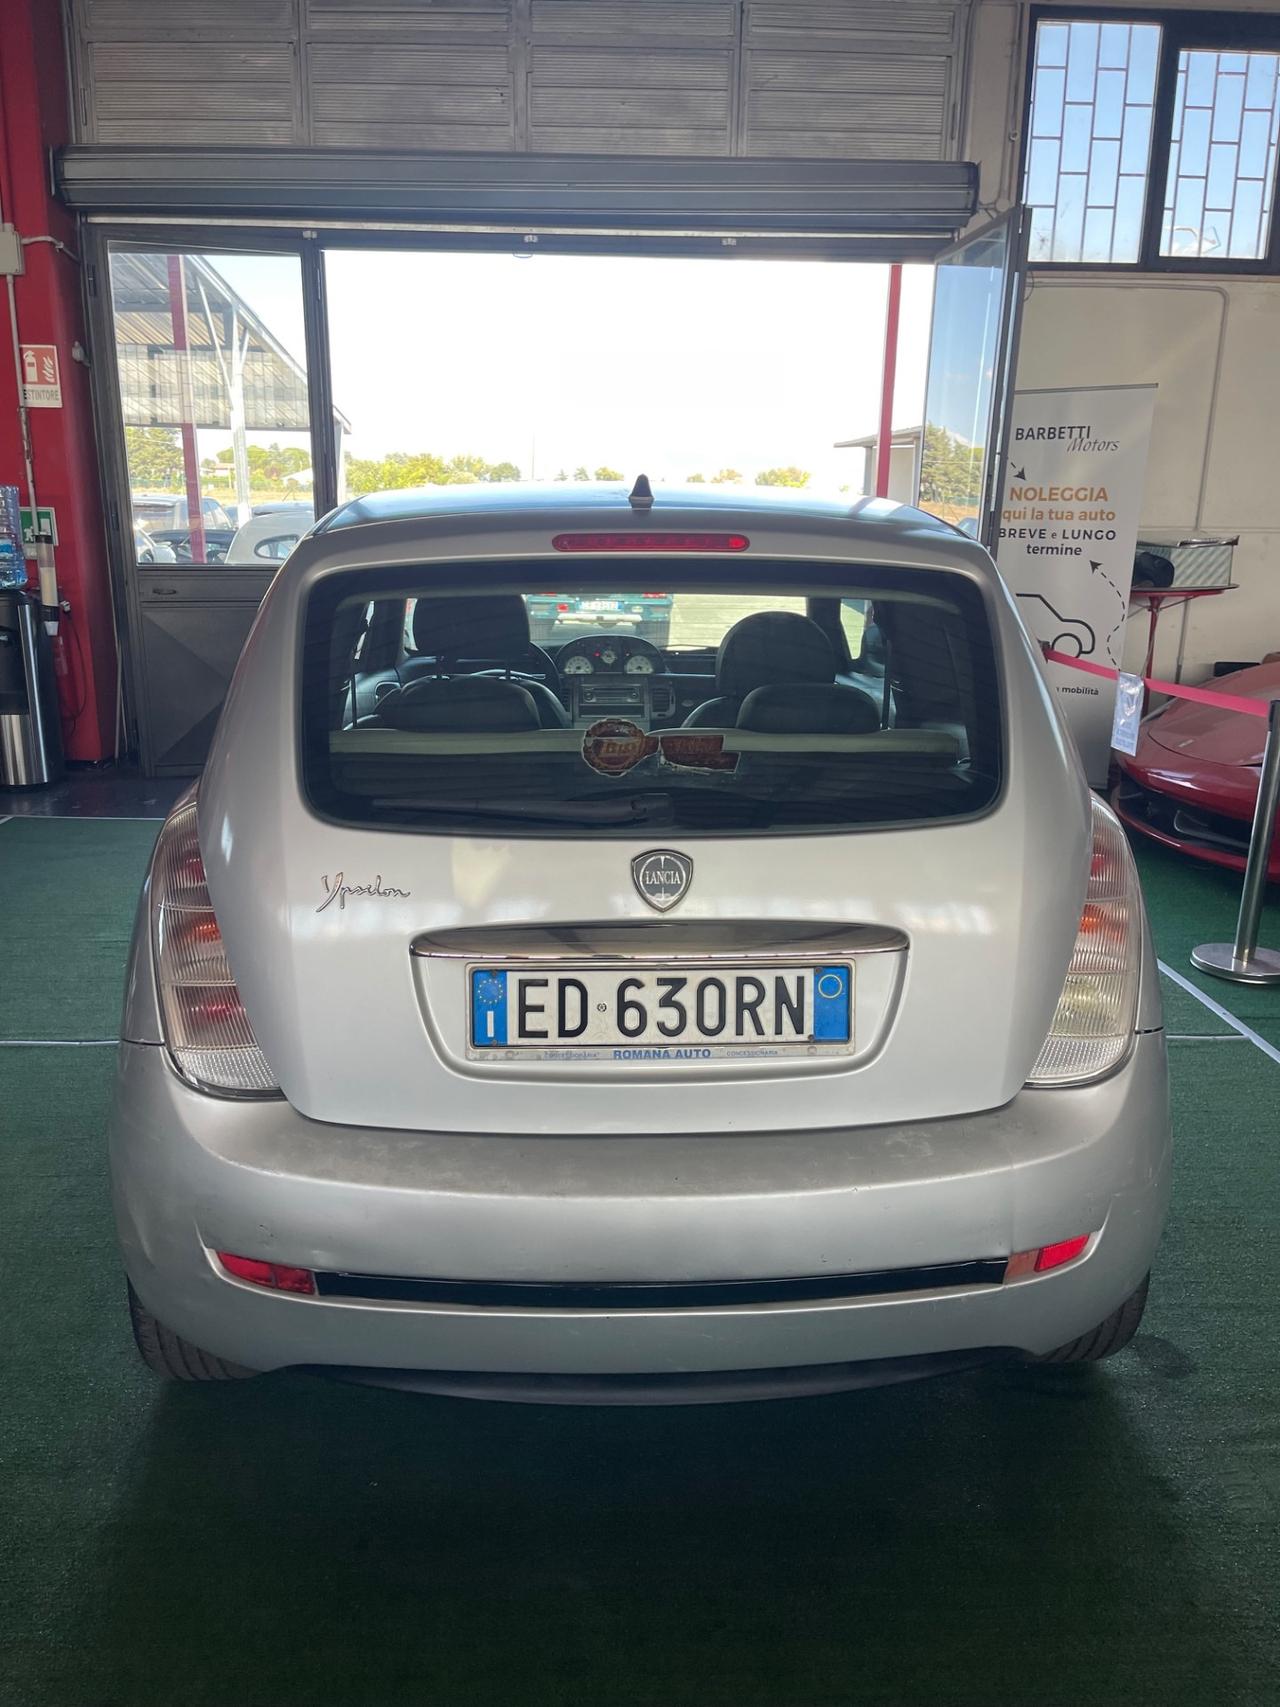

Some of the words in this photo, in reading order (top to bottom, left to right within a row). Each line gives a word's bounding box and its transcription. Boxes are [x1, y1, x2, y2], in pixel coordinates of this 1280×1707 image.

[1015, 425, 1091, 441] BARBETTI
[1066, 437, 1120, 453] Motors
[1009, 486, 1109, 502] NOLEGGIA
[1002, 507, 1027, 523] qui
[1031, 507, 1044, 521] la
[1048, 508, 1074, 521] tua
[1078, 508, 1116, 522] auto
[998, 527, 1047, 540] BREVE
[1051, 532, 1057, 540] e
[1062, 529, 1117, 541] LUNGO
[1026, 543, 1083, 556] termine
[645, 870, 681, 885] LANCIA
[315, 871, 412, 913] Ypsilon
[517, 977, 589, 1039] ED
[616, 975, 806, 1038] 630RN
[613, 1049, 673, 1060] ROMANA
[675, 1048, 712, 1060] AUTO
